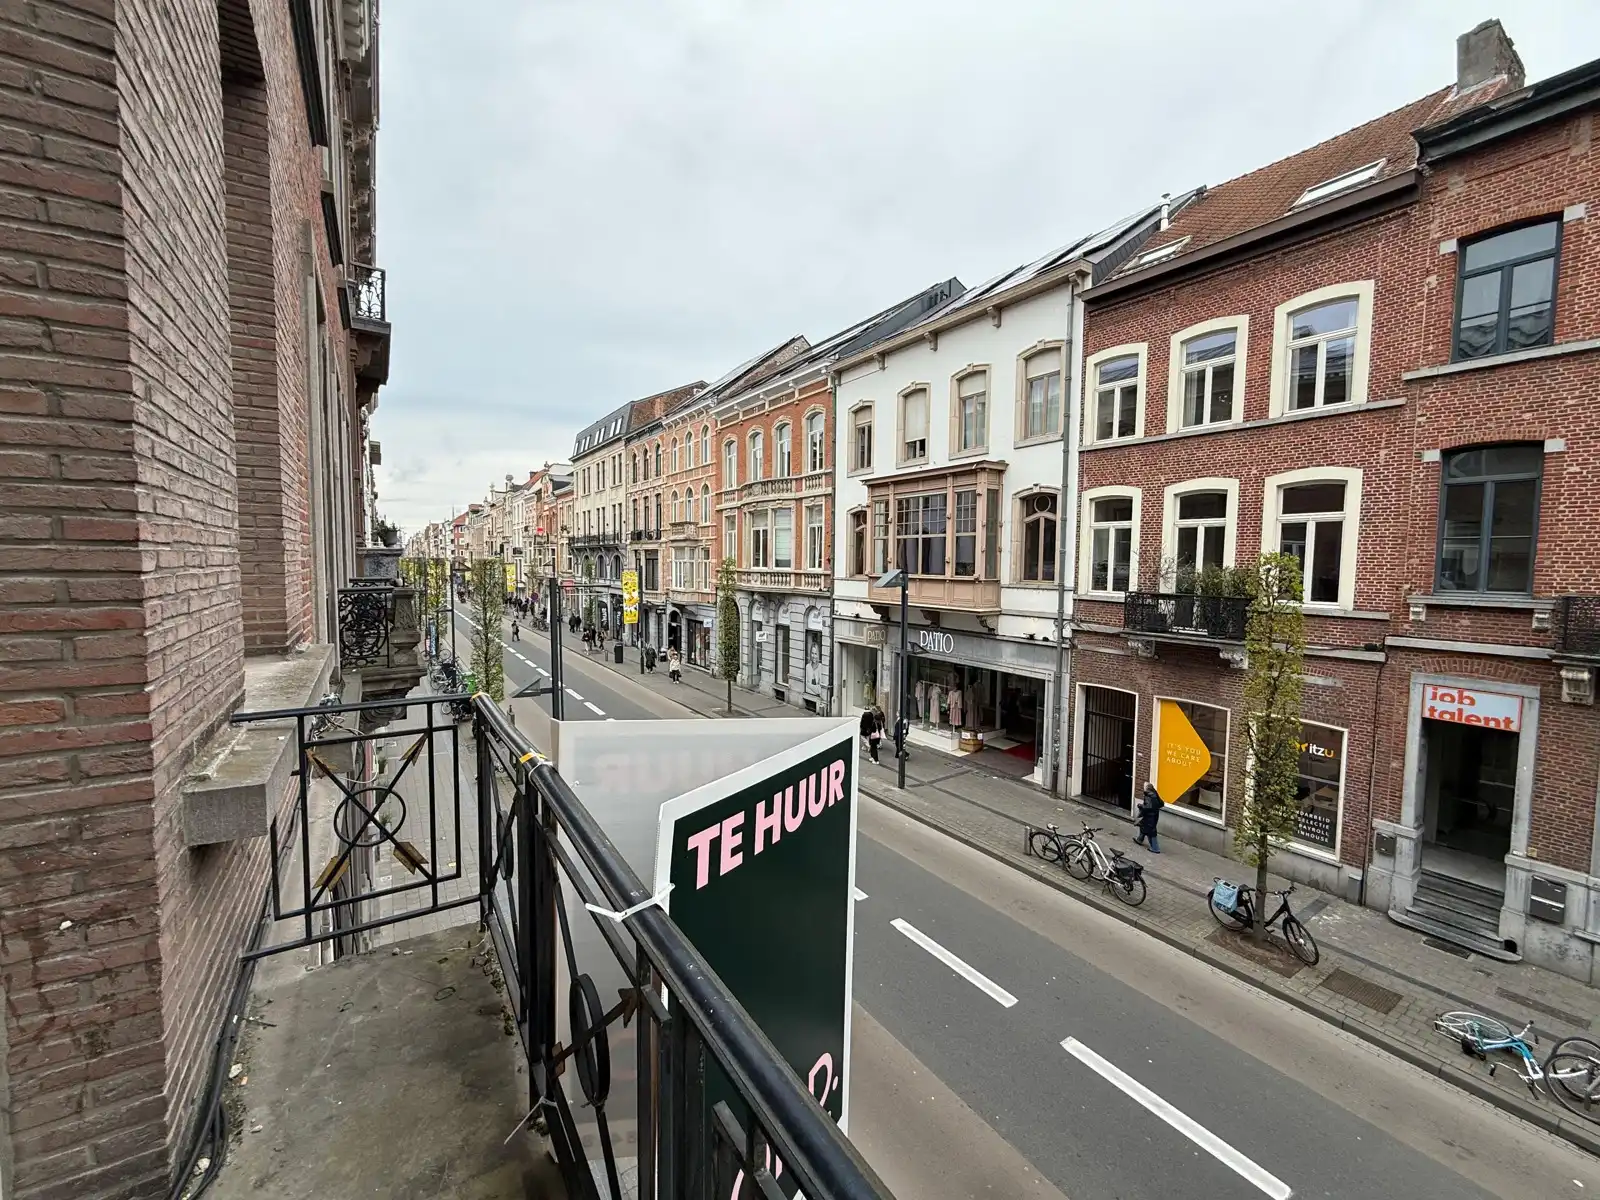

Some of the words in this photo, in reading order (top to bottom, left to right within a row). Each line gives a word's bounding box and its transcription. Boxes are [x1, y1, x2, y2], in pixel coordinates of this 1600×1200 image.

[867, 629, 886, 642] PATIO
[919, 630, 954, 654] PATIO
[1428, 705, 1514, 730] talent
[1166, 749, 1177, 757] WE
[1180, 752, 1201, 763] CARE
[1185, 746, 1201, 755] YOU
[1308, 743, 1335, 758] itzu
[1166, 756, 1192, 768] ABOUT
[687, 810, 745, 891] TE
[753, 758, 846, 856] HUUR
[1297, 816, 1330, 830] SELECTIE
[1298, 823, 1330, 837] PAYROLL
[1297, 830, 1329, 843] INHOUSE
